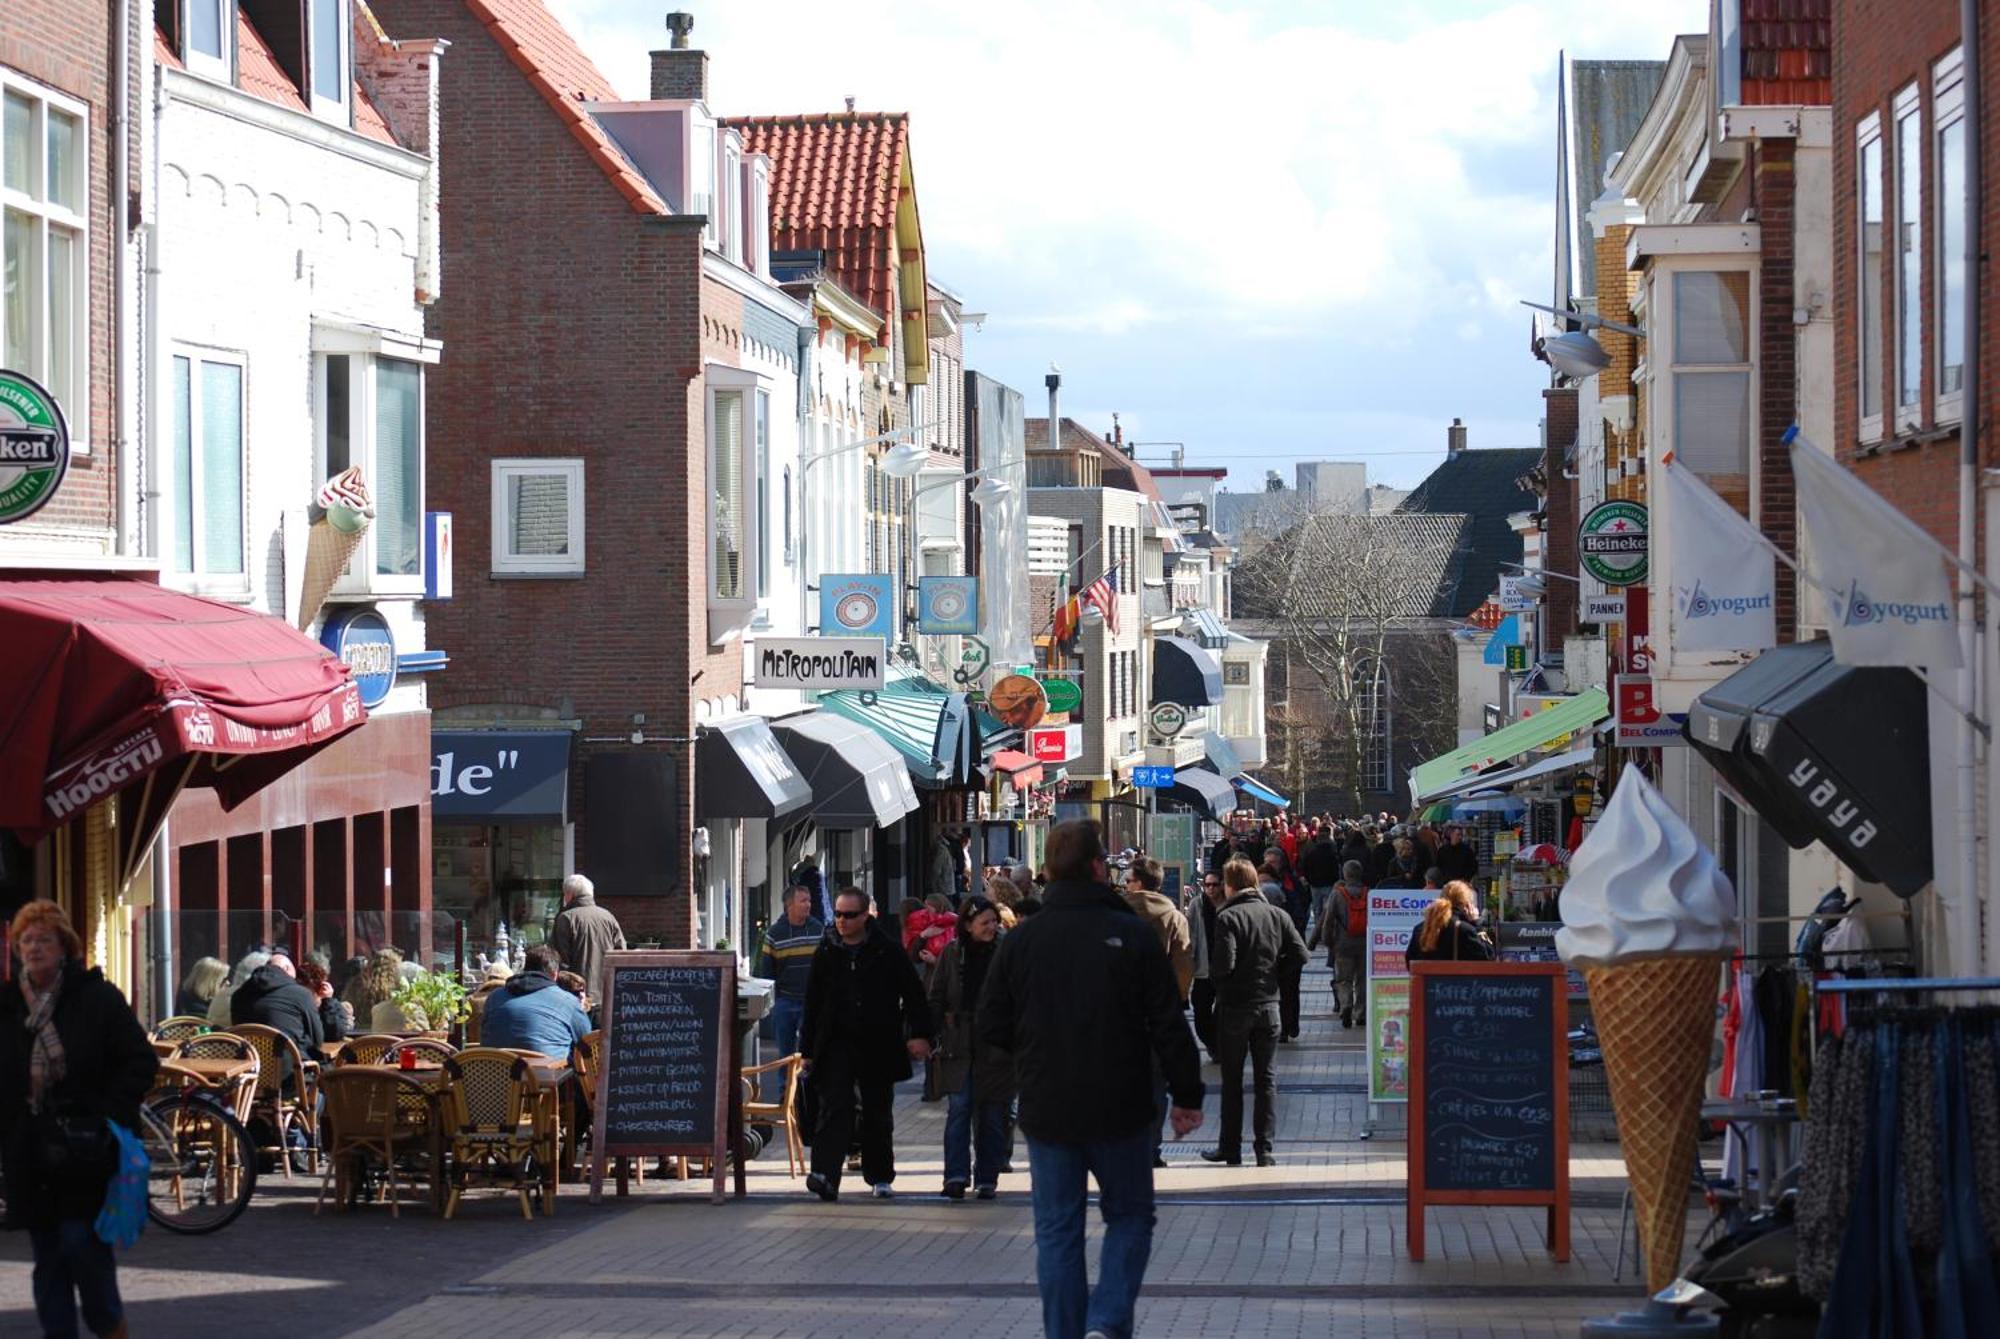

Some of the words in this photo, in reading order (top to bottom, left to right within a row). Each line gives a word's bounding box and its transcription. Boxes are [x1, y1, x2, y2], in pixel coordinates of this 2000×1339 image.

[1587, 536, 1648, 551] Heineke
[1711, 592, 1771, 617] yogurt
[1873, 595, 1949, 623] yogurt
[762, 648, 877, 682] METROPOLITAIN
